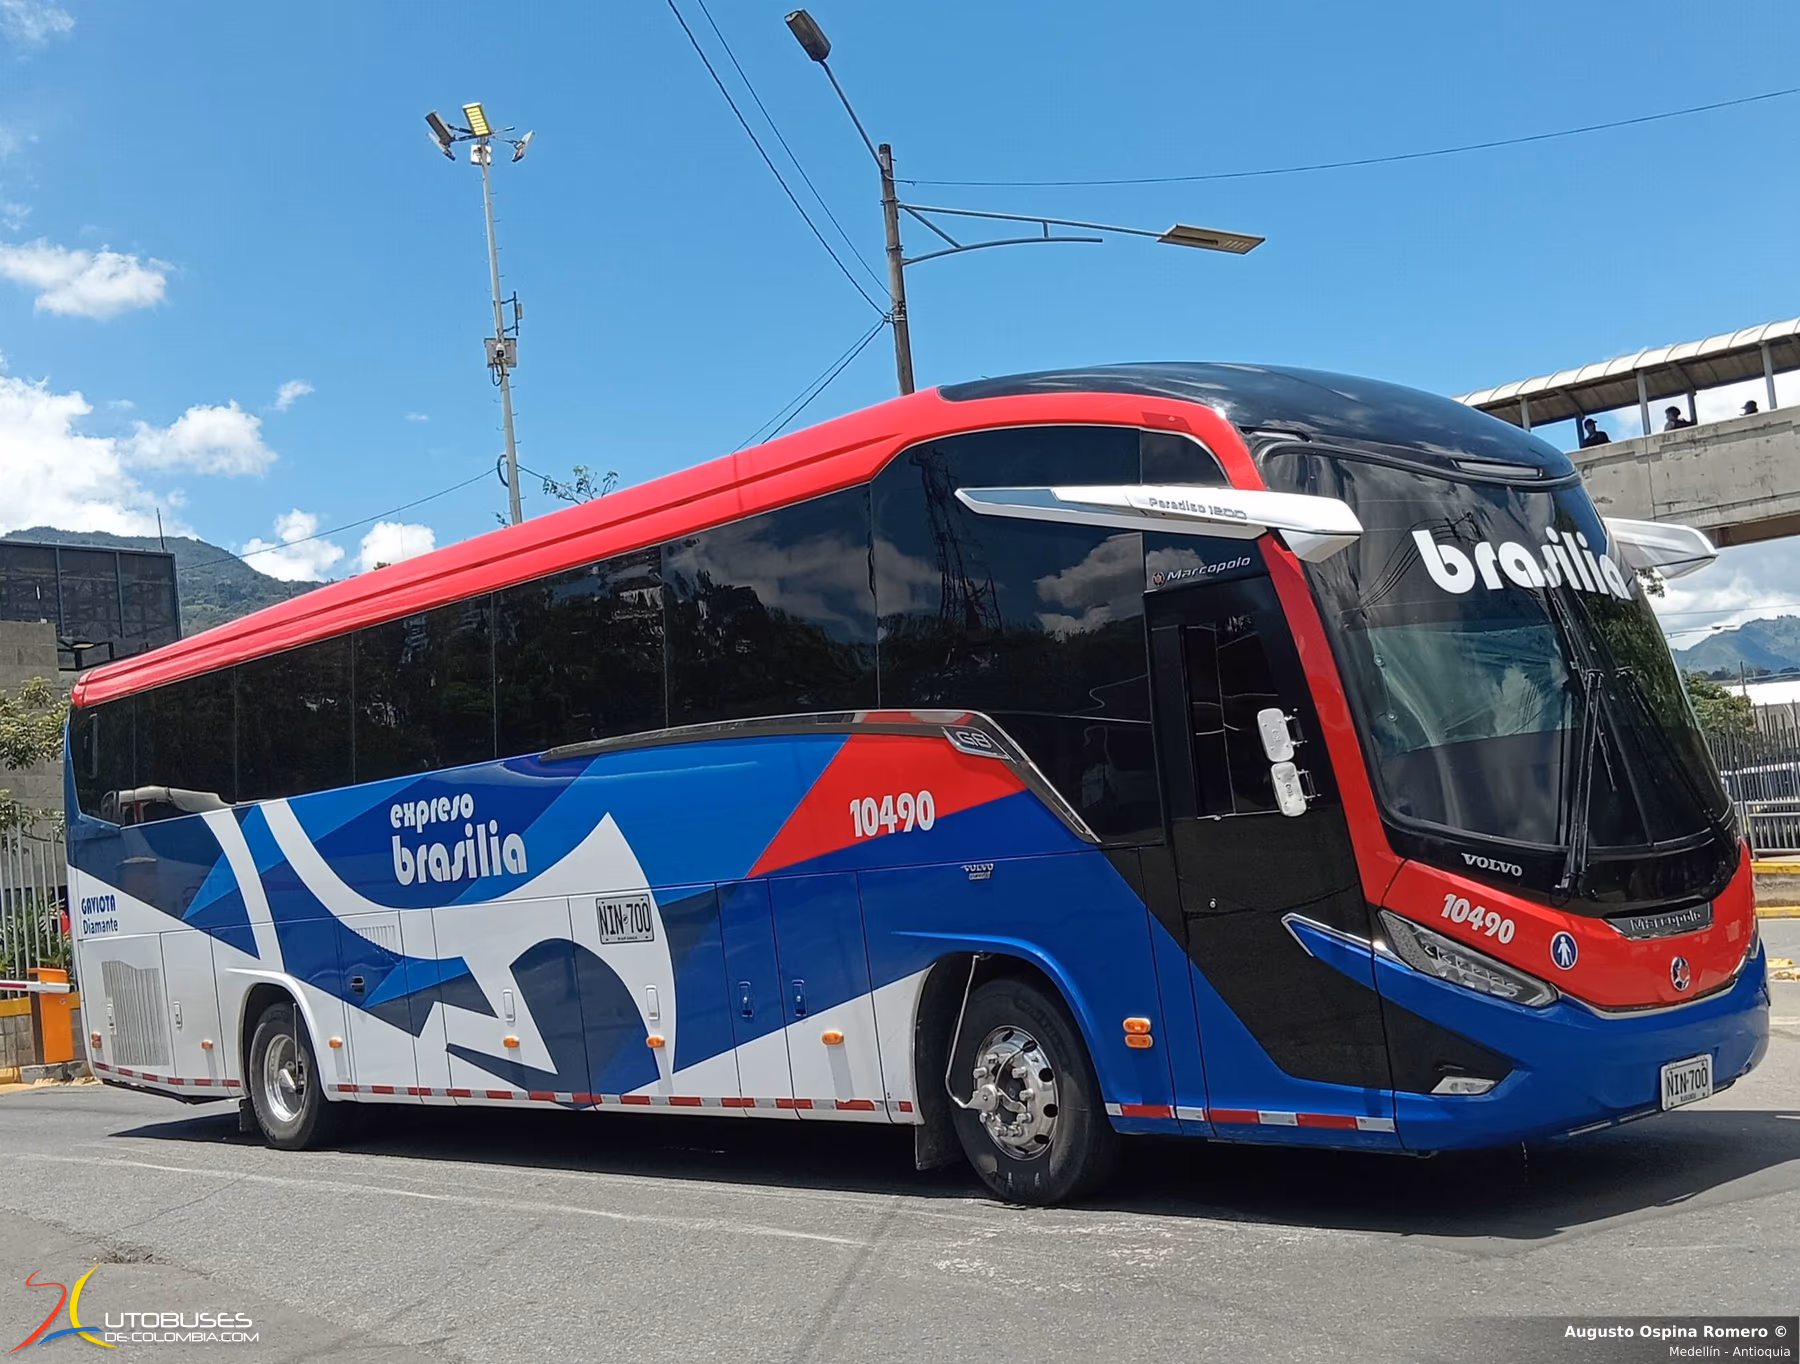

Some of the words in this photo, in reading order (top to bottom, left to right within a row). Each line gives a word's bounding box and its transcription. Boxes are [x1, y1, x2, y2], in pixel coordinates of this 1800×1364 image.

[1208, 504, 1248, 520] 1200
[1166, 556, 1251, 581] Marcopolo
[1411, 526, 1633, 601] brasilia
[390, 793, 474, 833] expreso
[849, 790, 935, 837] 10490
[391, 819, 527, 886] brasilia
[1460, 852, 1523, 876] VOLVO
[82, 917, 118, 935] Diamante
[1440, 893, 1515, 944] 10490
